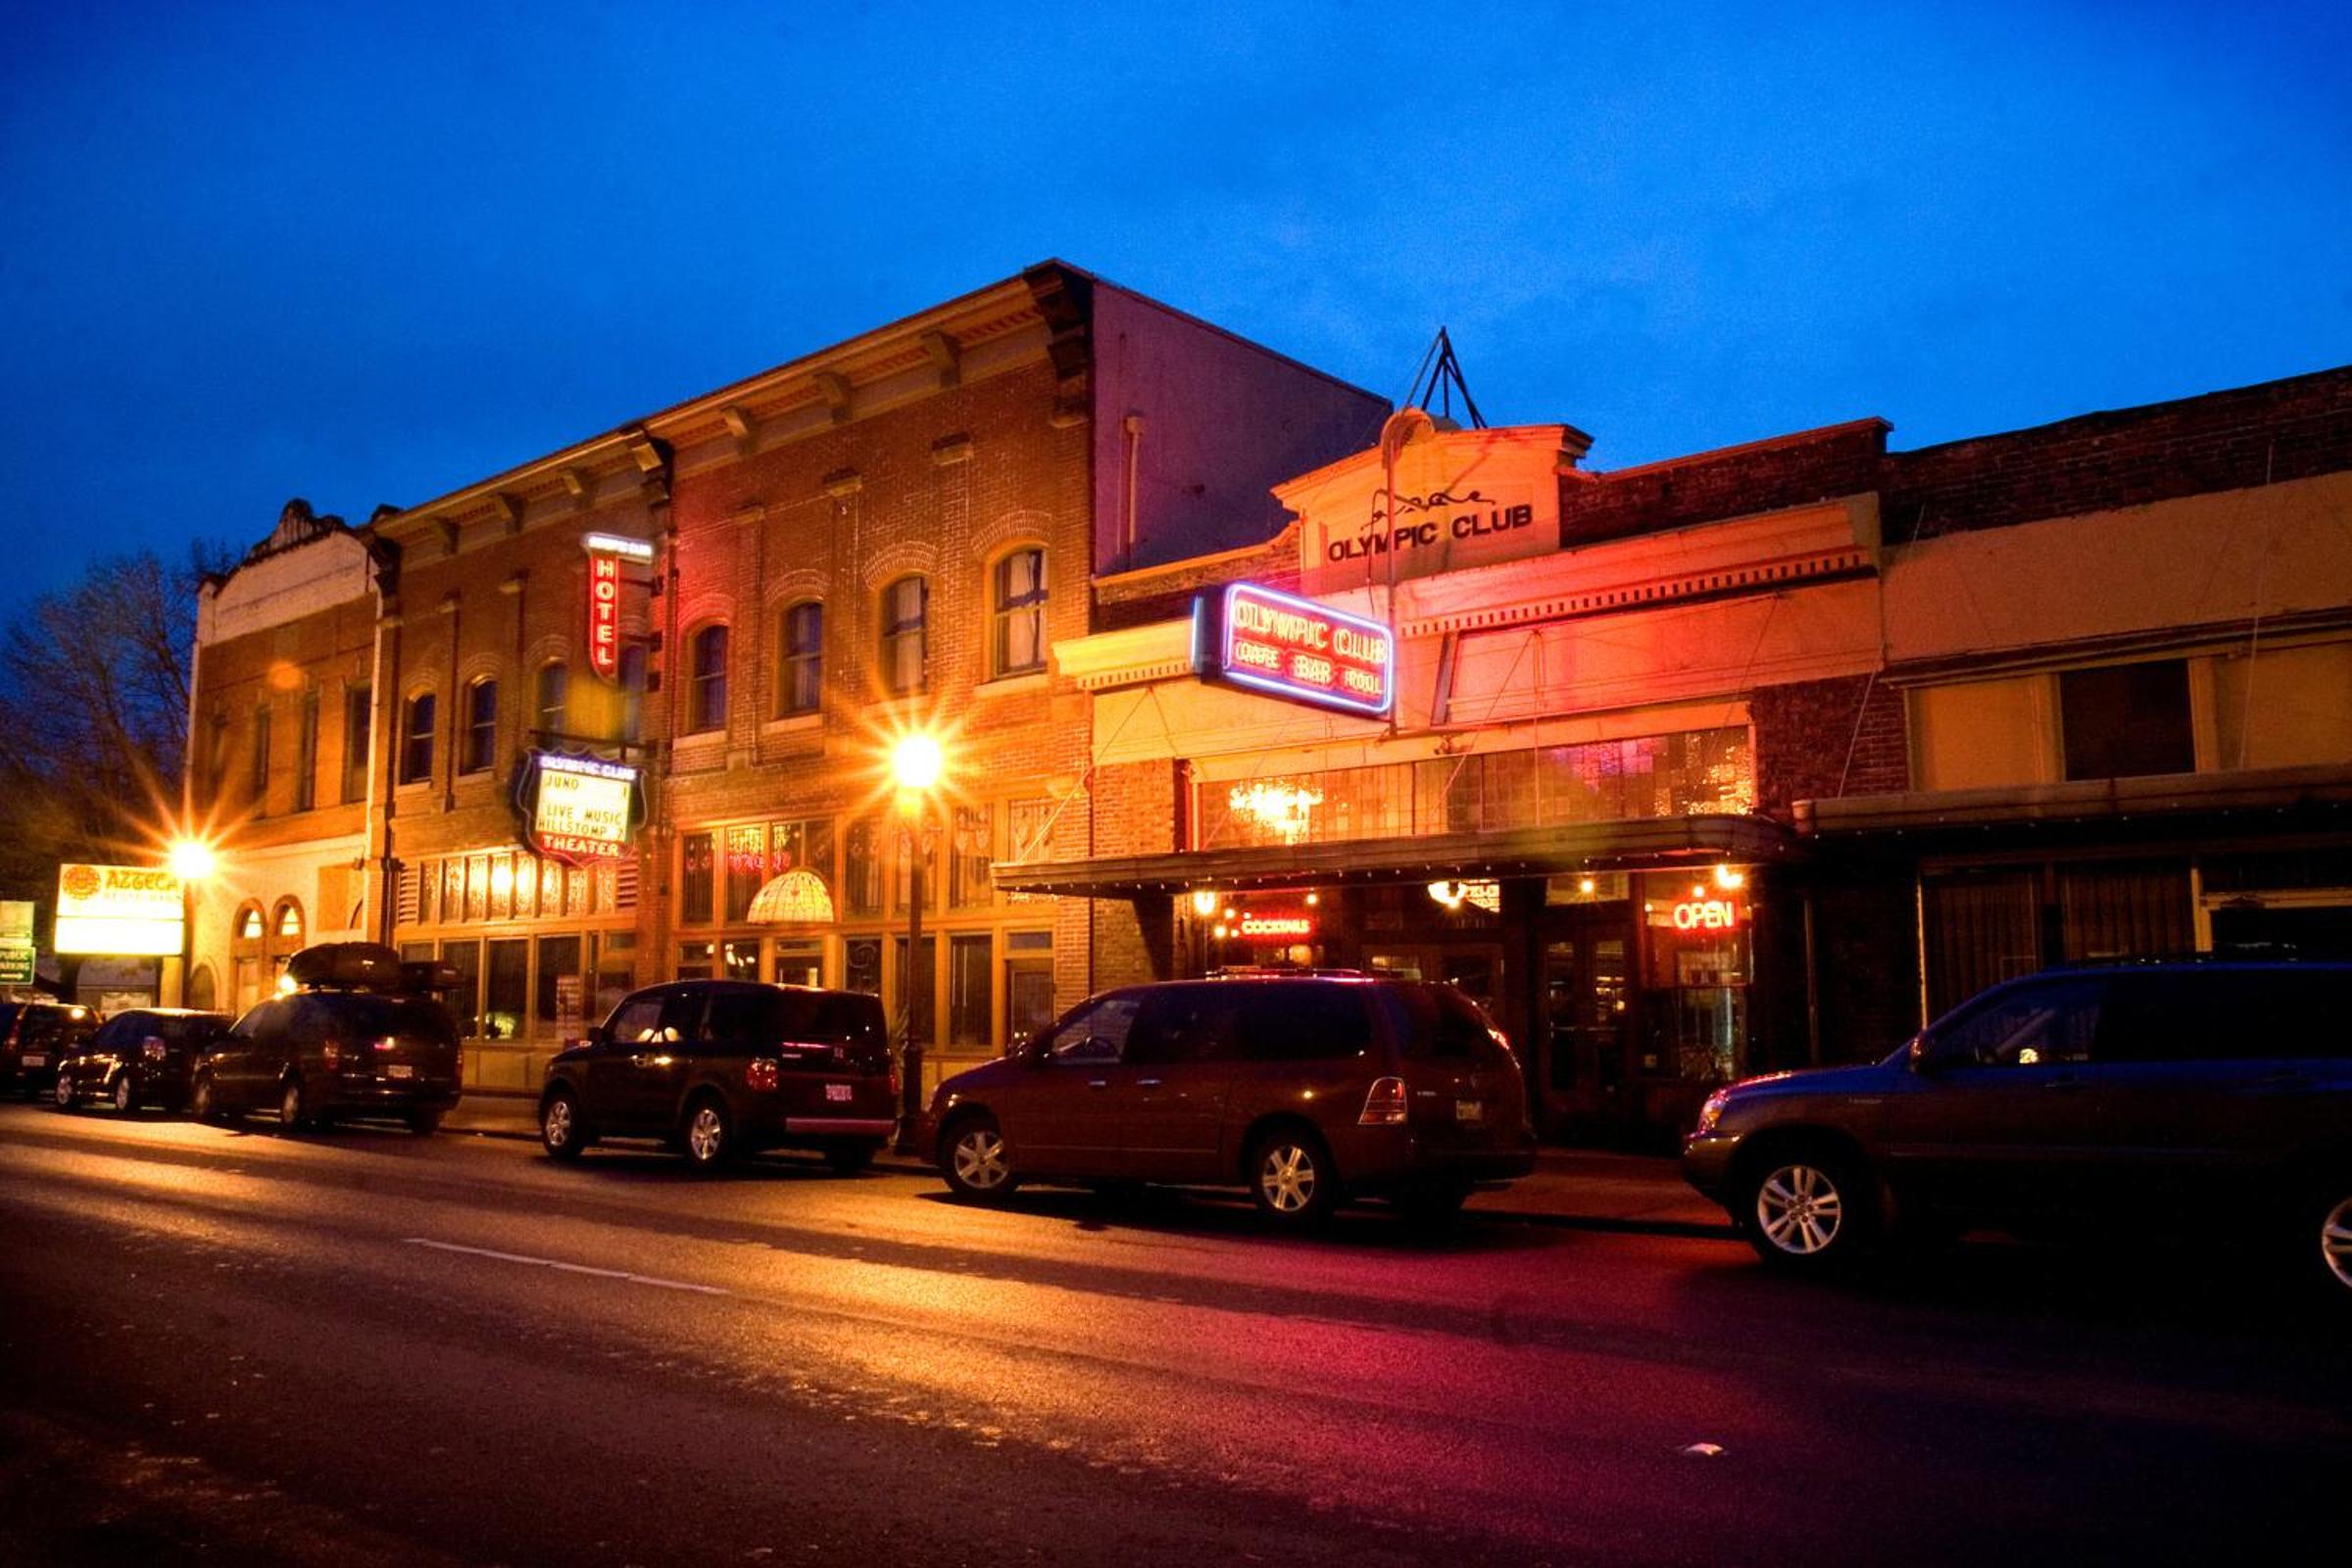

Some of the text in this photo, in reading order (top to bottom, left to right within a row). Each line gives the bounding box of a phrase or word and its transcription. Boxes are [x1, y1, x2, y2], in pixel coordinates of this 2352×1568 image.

[1329, 504, 1532, 562] OLYMPIC CLUB
[596, 560, 613, 664] HOTEL
[1234, 600, 1386, 664] OLYMPIC CLUB
[1293, 655, 1331, 684] BAR
[1345, 669, 1383, 695] POOL
[545, 774, 580, 791] JUNO
[546, 805, 621, 825] LIVE MUSIC
[542, 834, 619, 857] THEATER
[106, 869, 177, 891] AZTECA
[1674, 901, 1733, 929] OPEN
